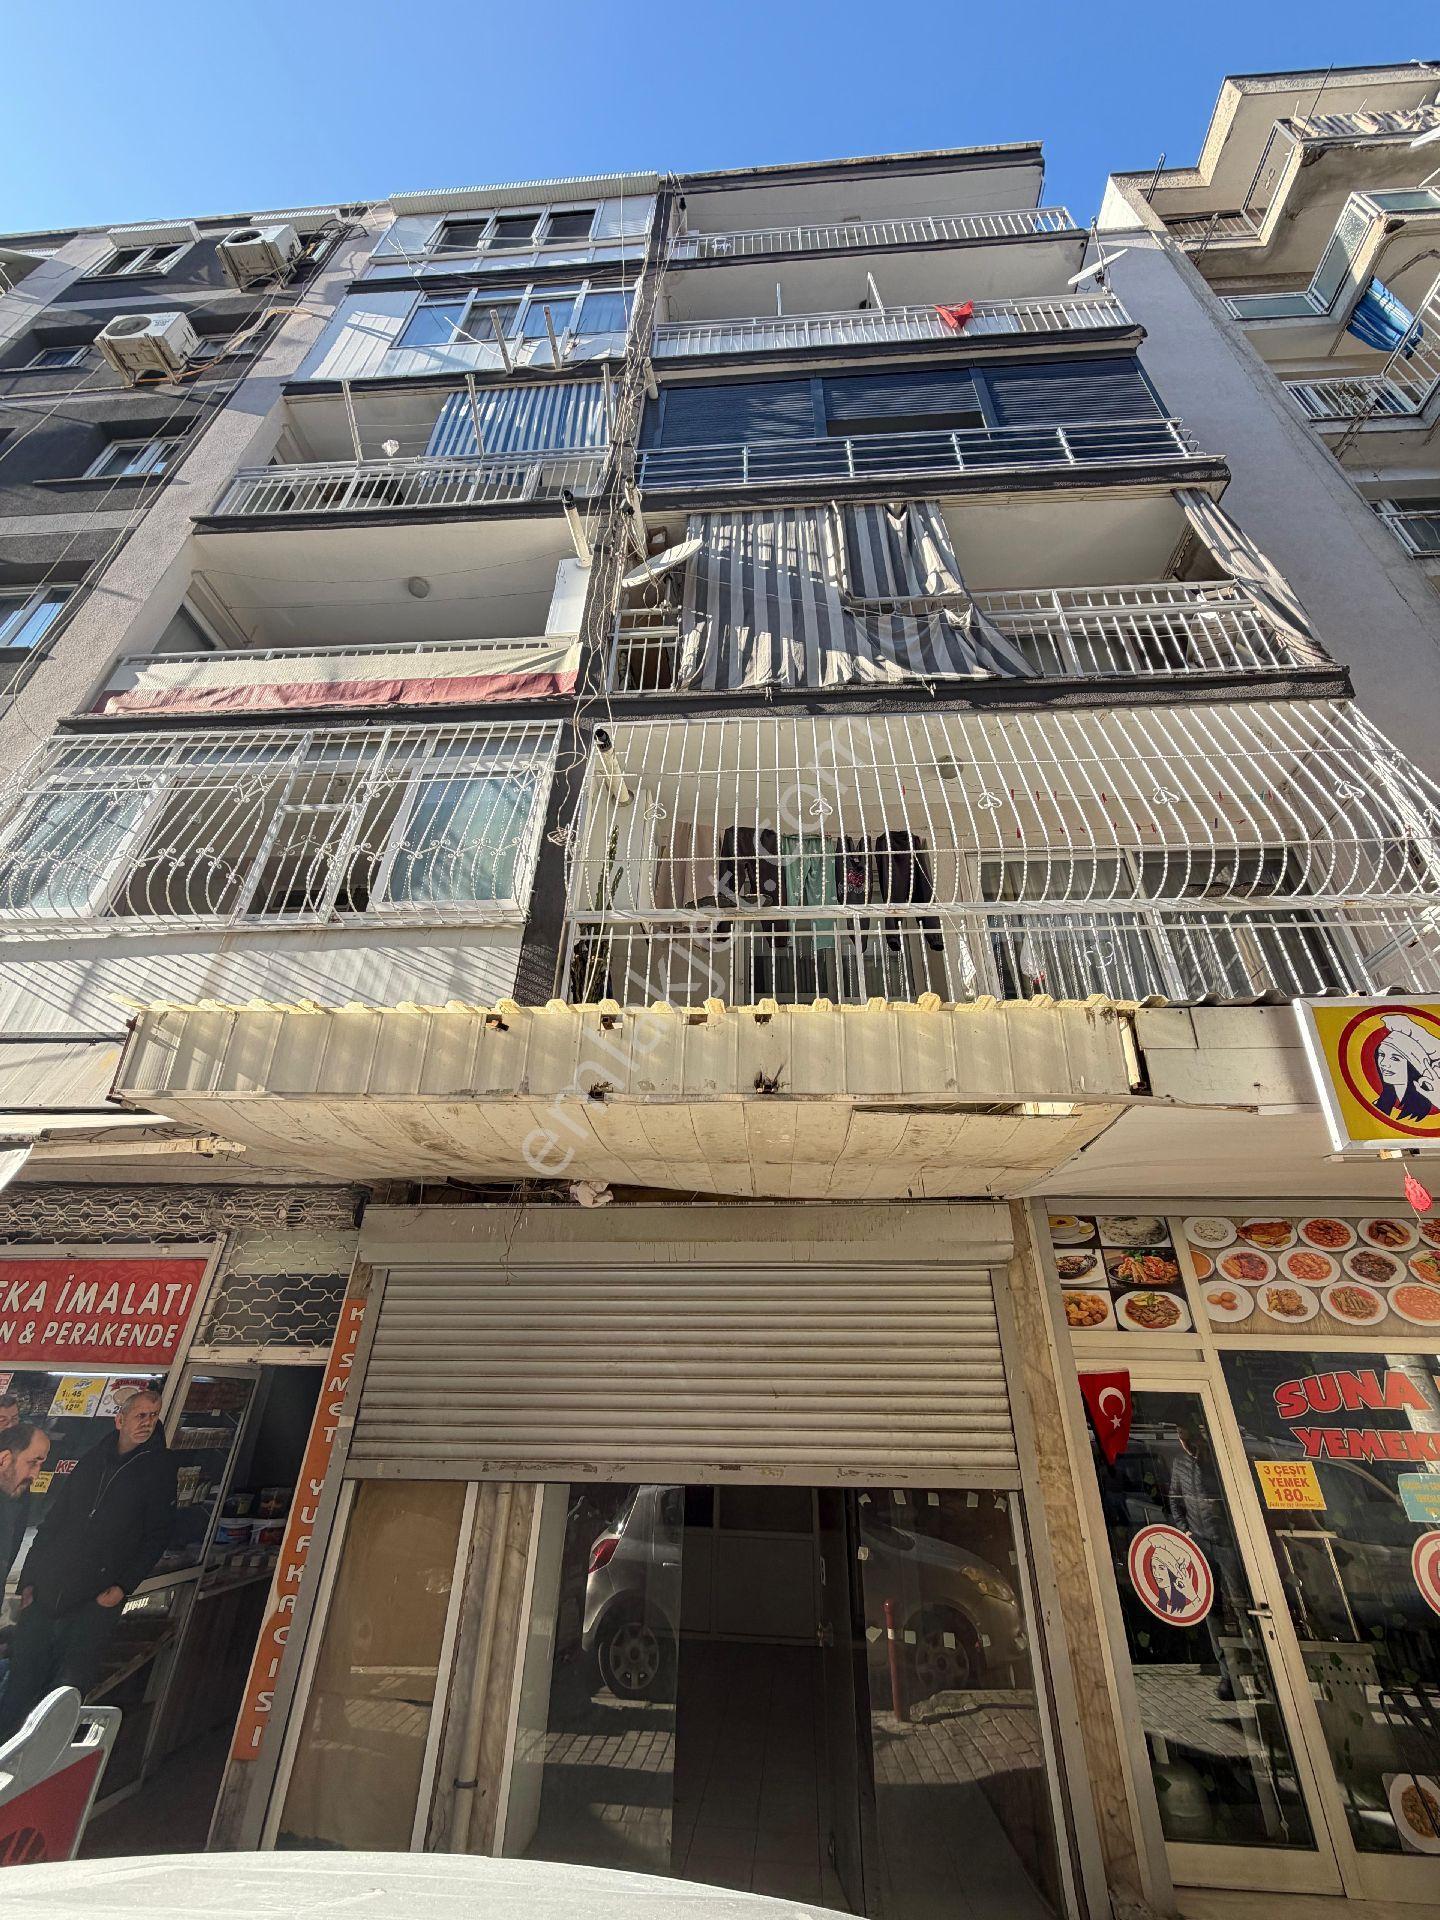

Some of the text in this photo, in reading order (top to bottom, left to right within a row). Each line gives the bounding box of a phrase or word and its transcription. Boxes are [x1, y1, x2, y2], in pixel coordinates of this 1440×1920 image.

[54, 1273, 193, 1316] İMALATI
[18, 1320, 36, 1345] &
[40, 1321, 179, 1347] PERAKENDE
[1273, 1369, 1434, 1420] SUNA
[1263, 1462, 1307, 1477] 3 ÇEŞİT
[1268, 1477, 1310, 1488] YEMEK
[1274, 1488, 1304, 1502] 180
